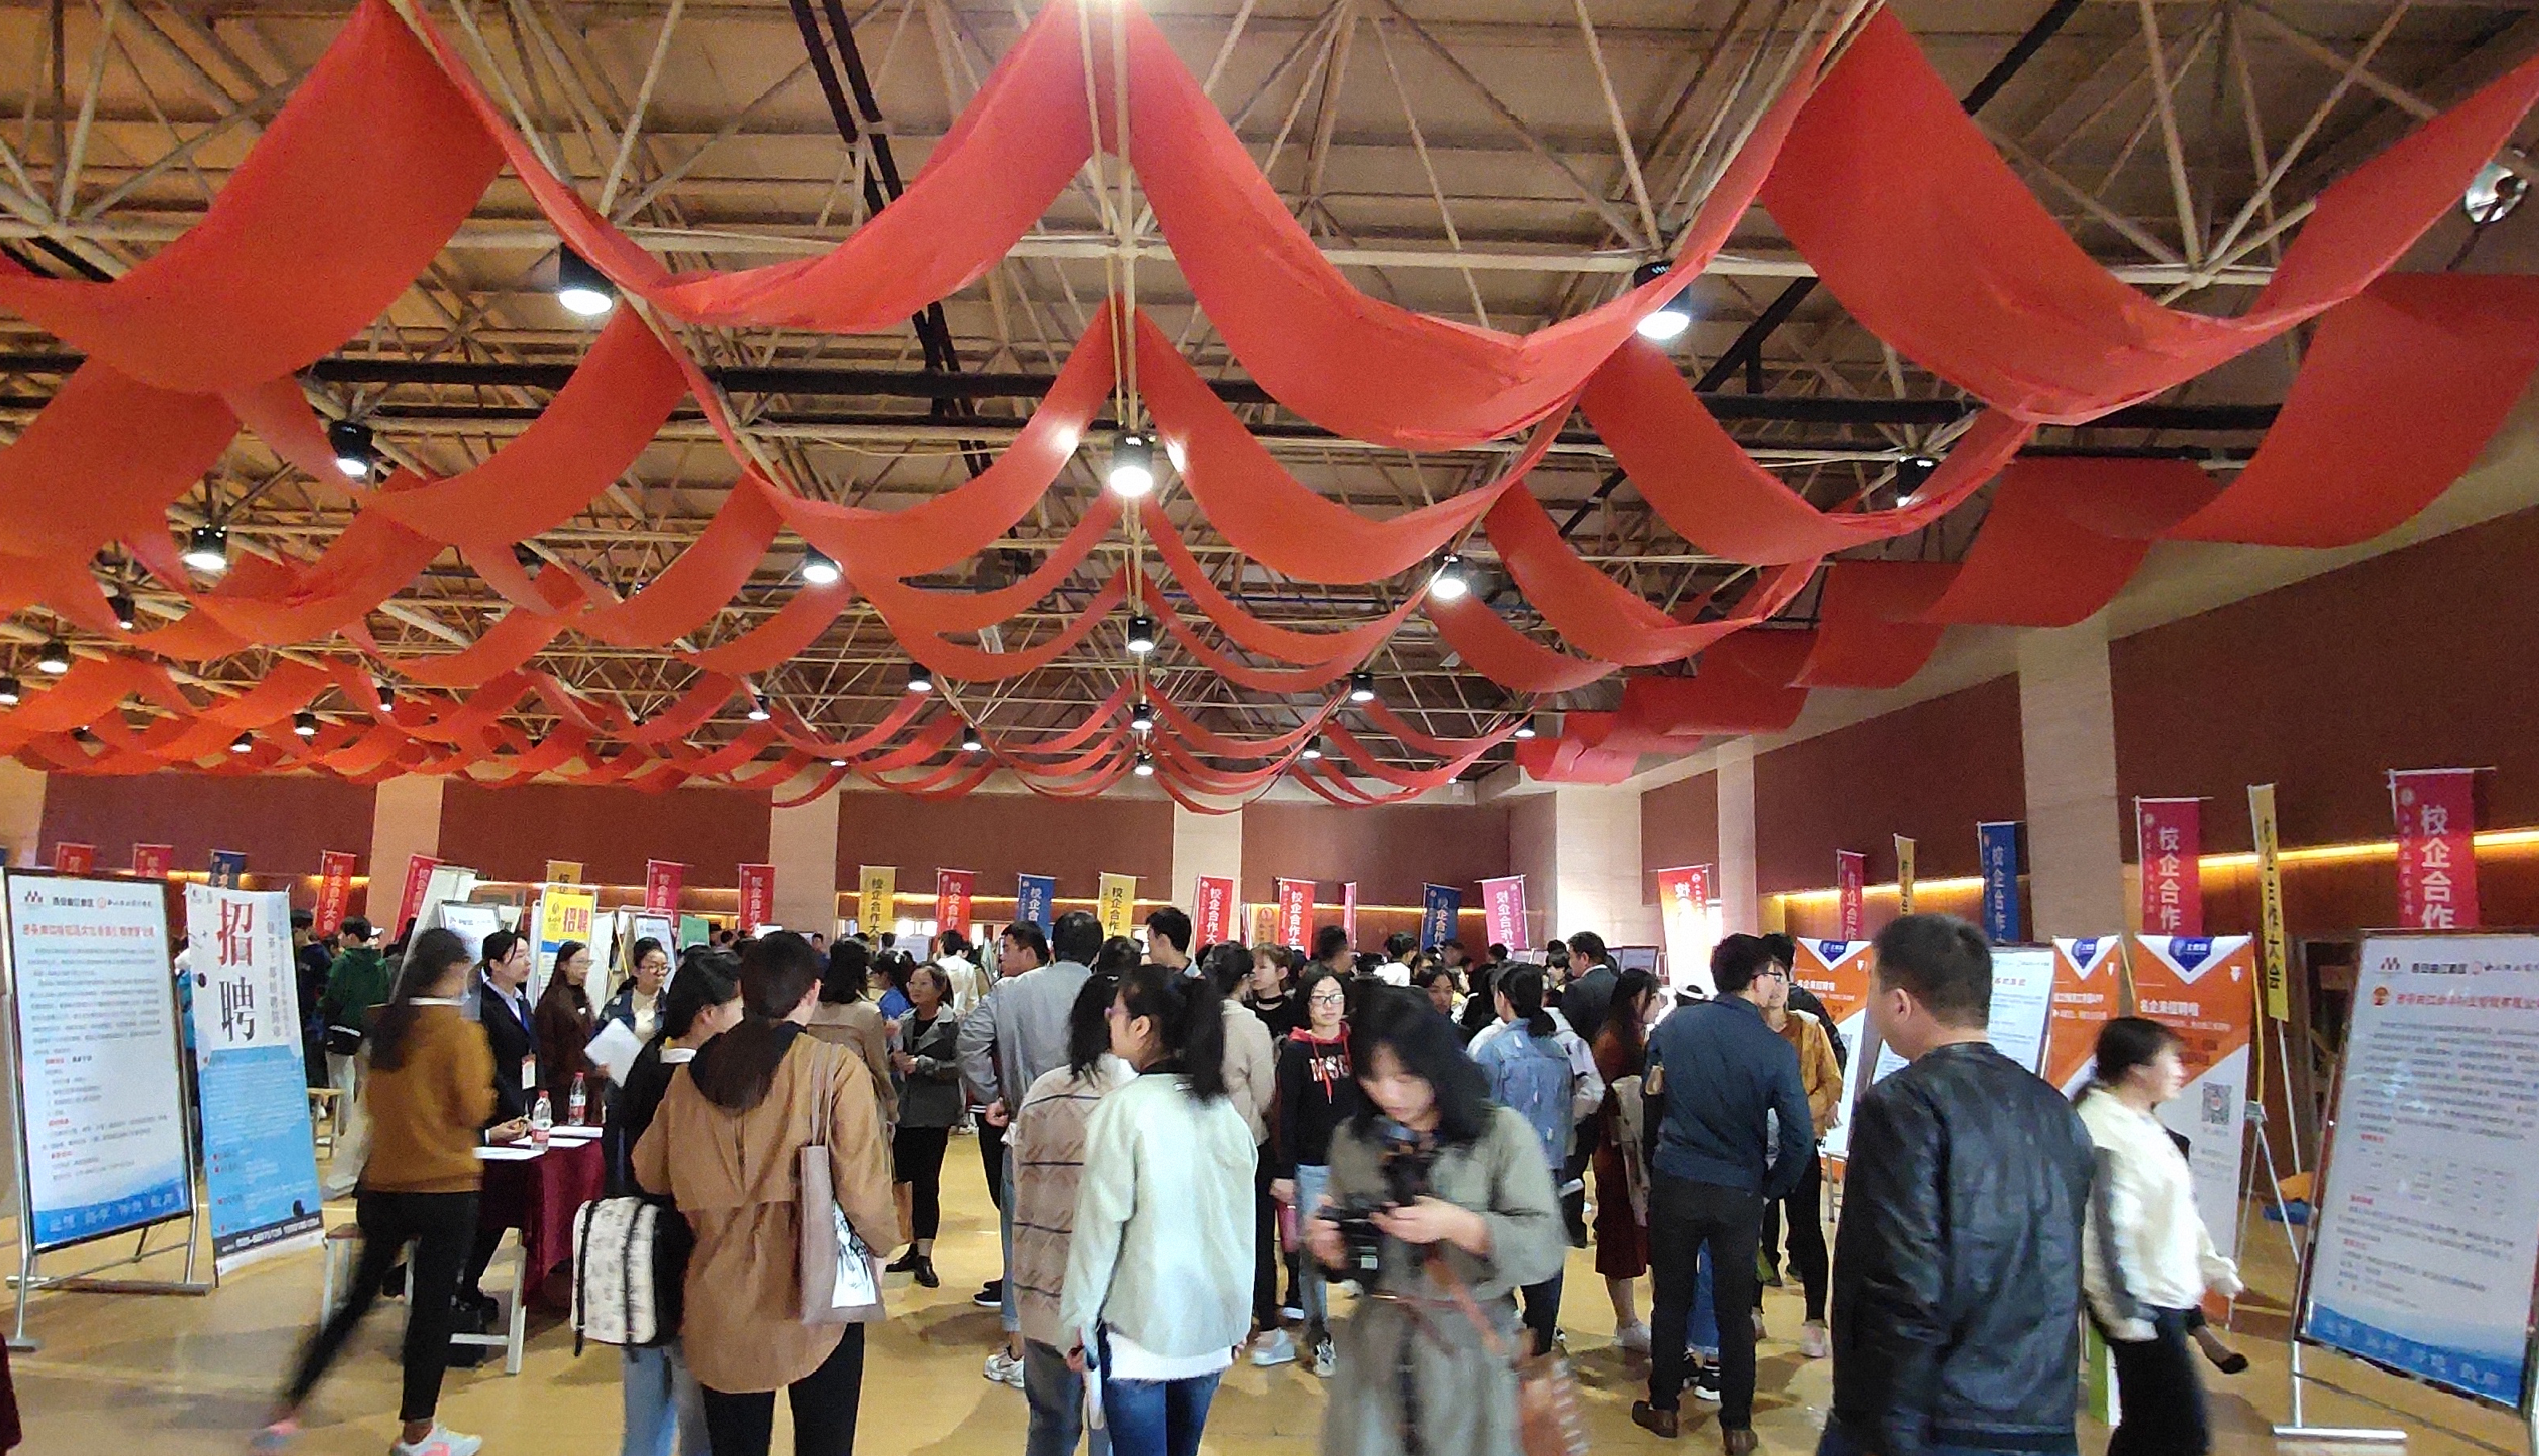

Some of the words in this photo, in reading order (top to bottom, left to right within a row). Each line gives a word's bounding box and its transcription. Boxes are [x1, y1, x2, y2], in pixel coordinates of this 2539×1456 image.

[2421, 804, 2455, 929] 校企合作
[217, 899, 256, 1042] 招聘
